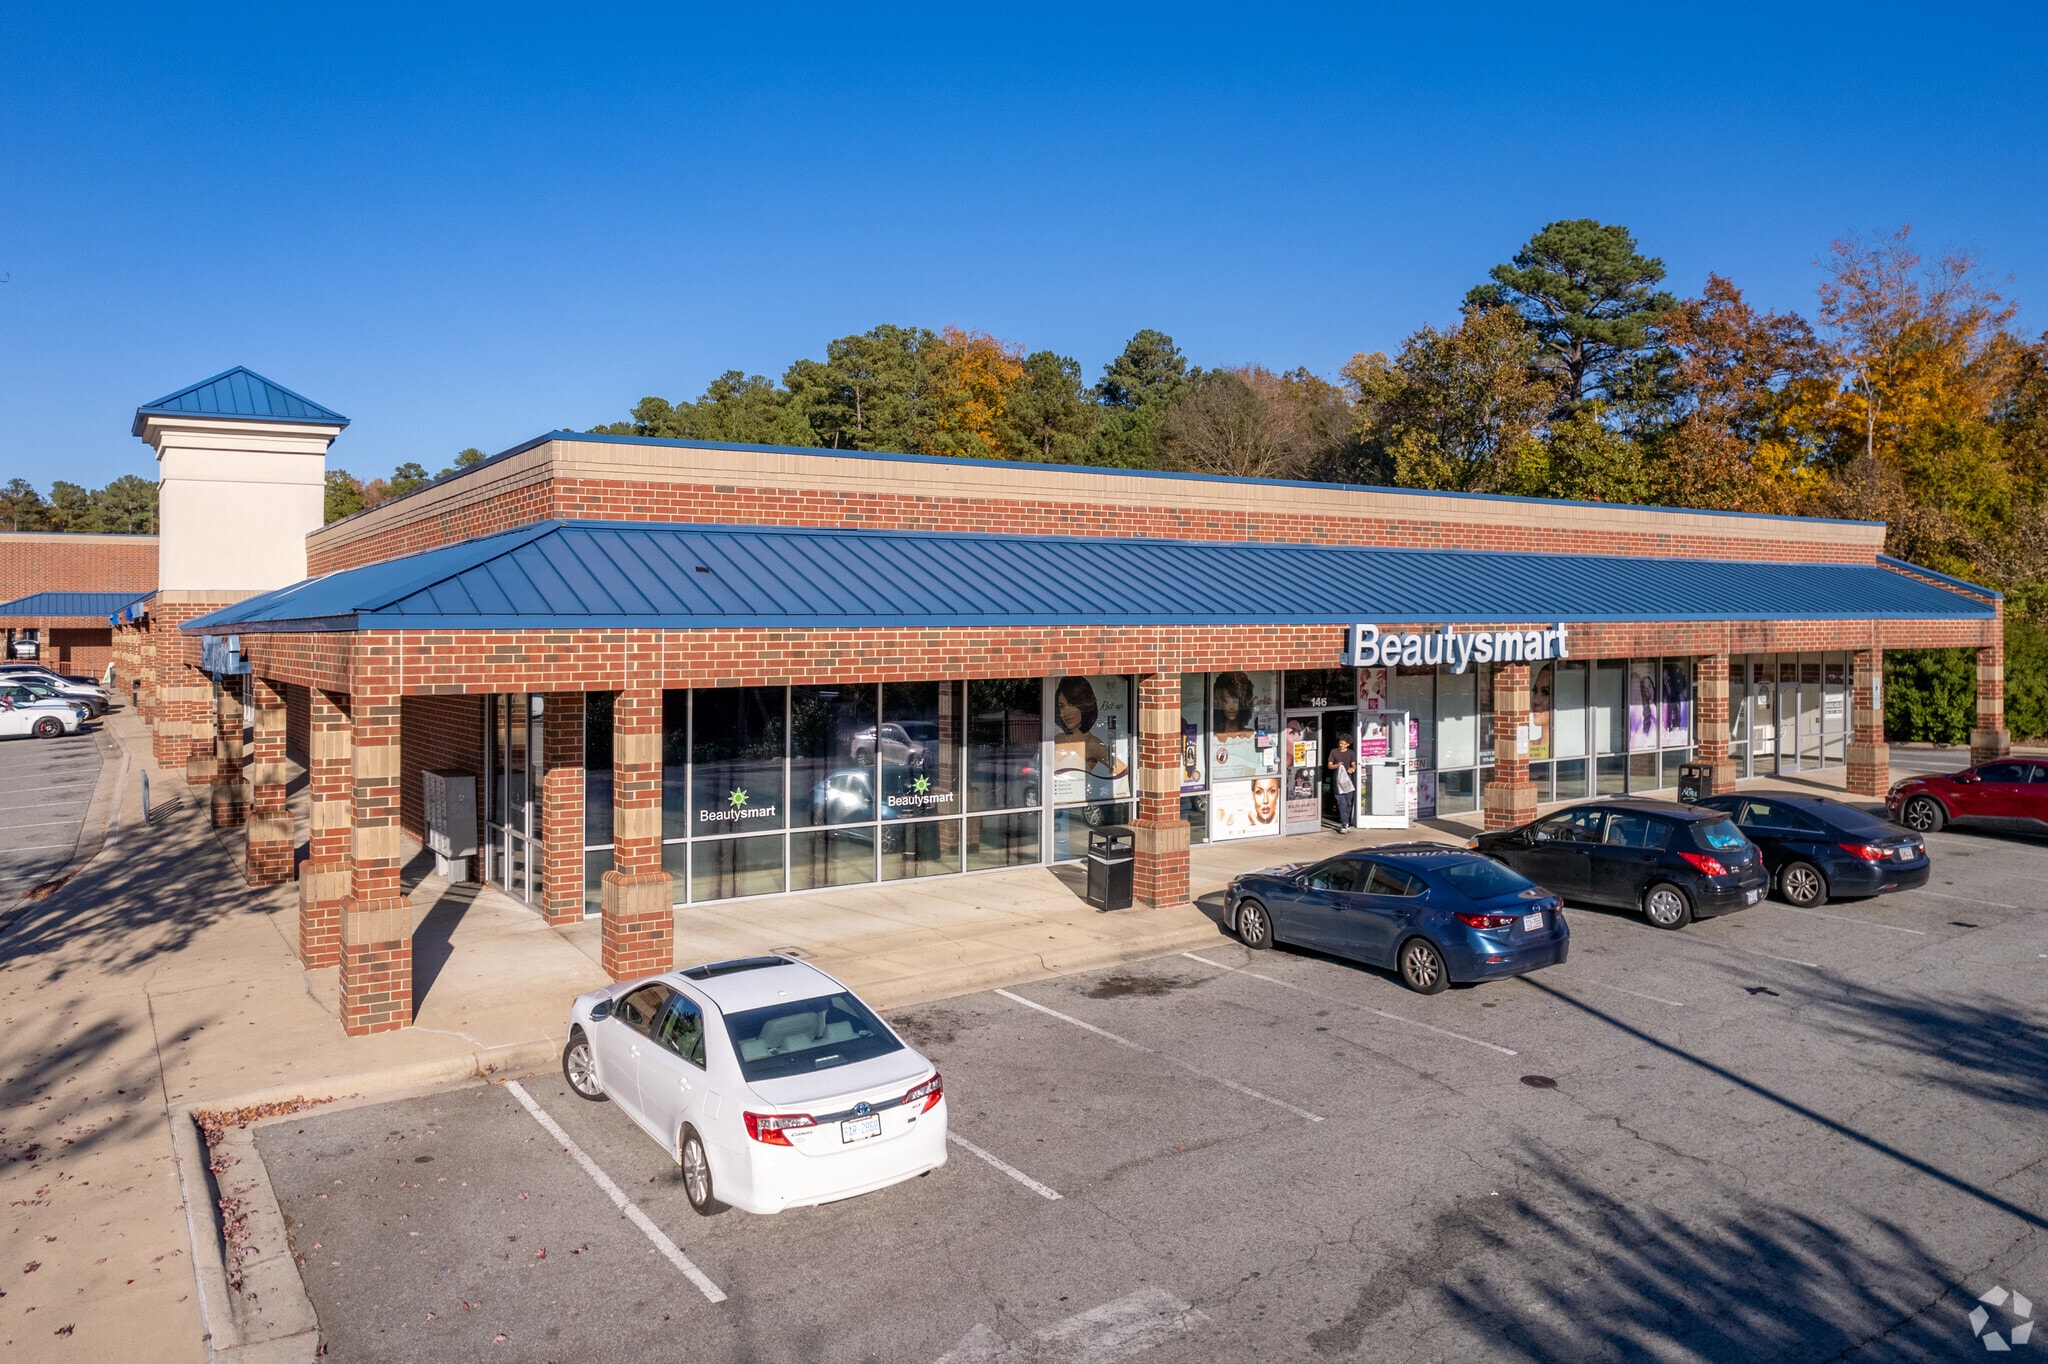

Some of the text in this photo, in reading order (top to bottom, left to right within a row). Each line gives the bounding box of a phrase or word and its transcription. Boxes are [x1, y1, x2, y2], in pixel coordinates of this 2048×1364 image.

[1354, 622, 1569, 675] Beautysmart
[1311, 697, 1328, 707] 146
[888, 791, 954, 807] Beautysmart
[700, 805, 776, 822] Beautysmart
